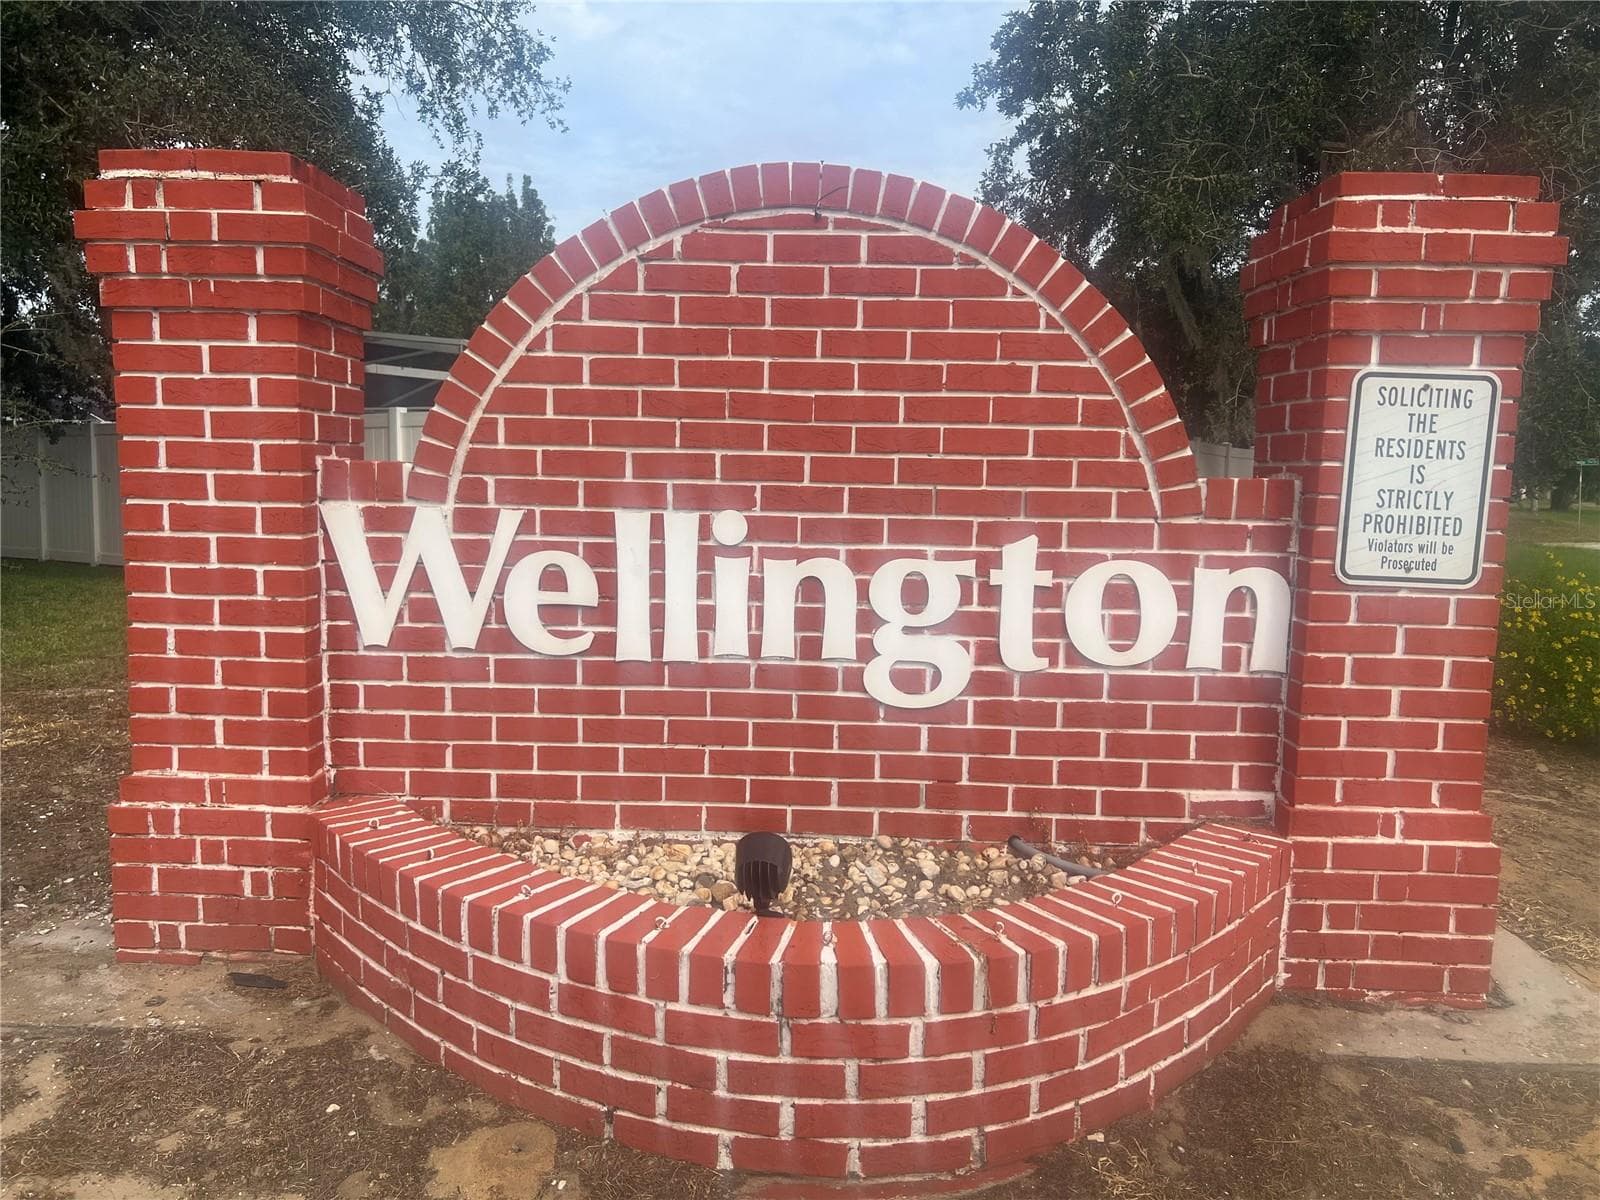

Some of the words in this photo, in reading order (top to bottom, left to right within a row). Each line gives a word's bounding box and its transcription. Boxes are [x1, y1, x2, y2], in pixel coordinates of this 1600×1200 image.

[1377, 386, 1474, 409] SOLICITING
[1408, 413, 1439, 434] THE
[1375, 437, 1466, 460] RESIDENTS
[1410, 464, 1426, 484] IS
[1376, 488, 1454, 511] STRICTLY
[1362, 513, 1463, 537] PROHIBITED
[1368, 538, 1413, 554] Violators
[1418, 540, 1437, 555] will
[1442, 541, 1454, 555] be
[1381, 555, 1437, 571] Prosecuted
[319, 505, 1294, 709] Wellington
